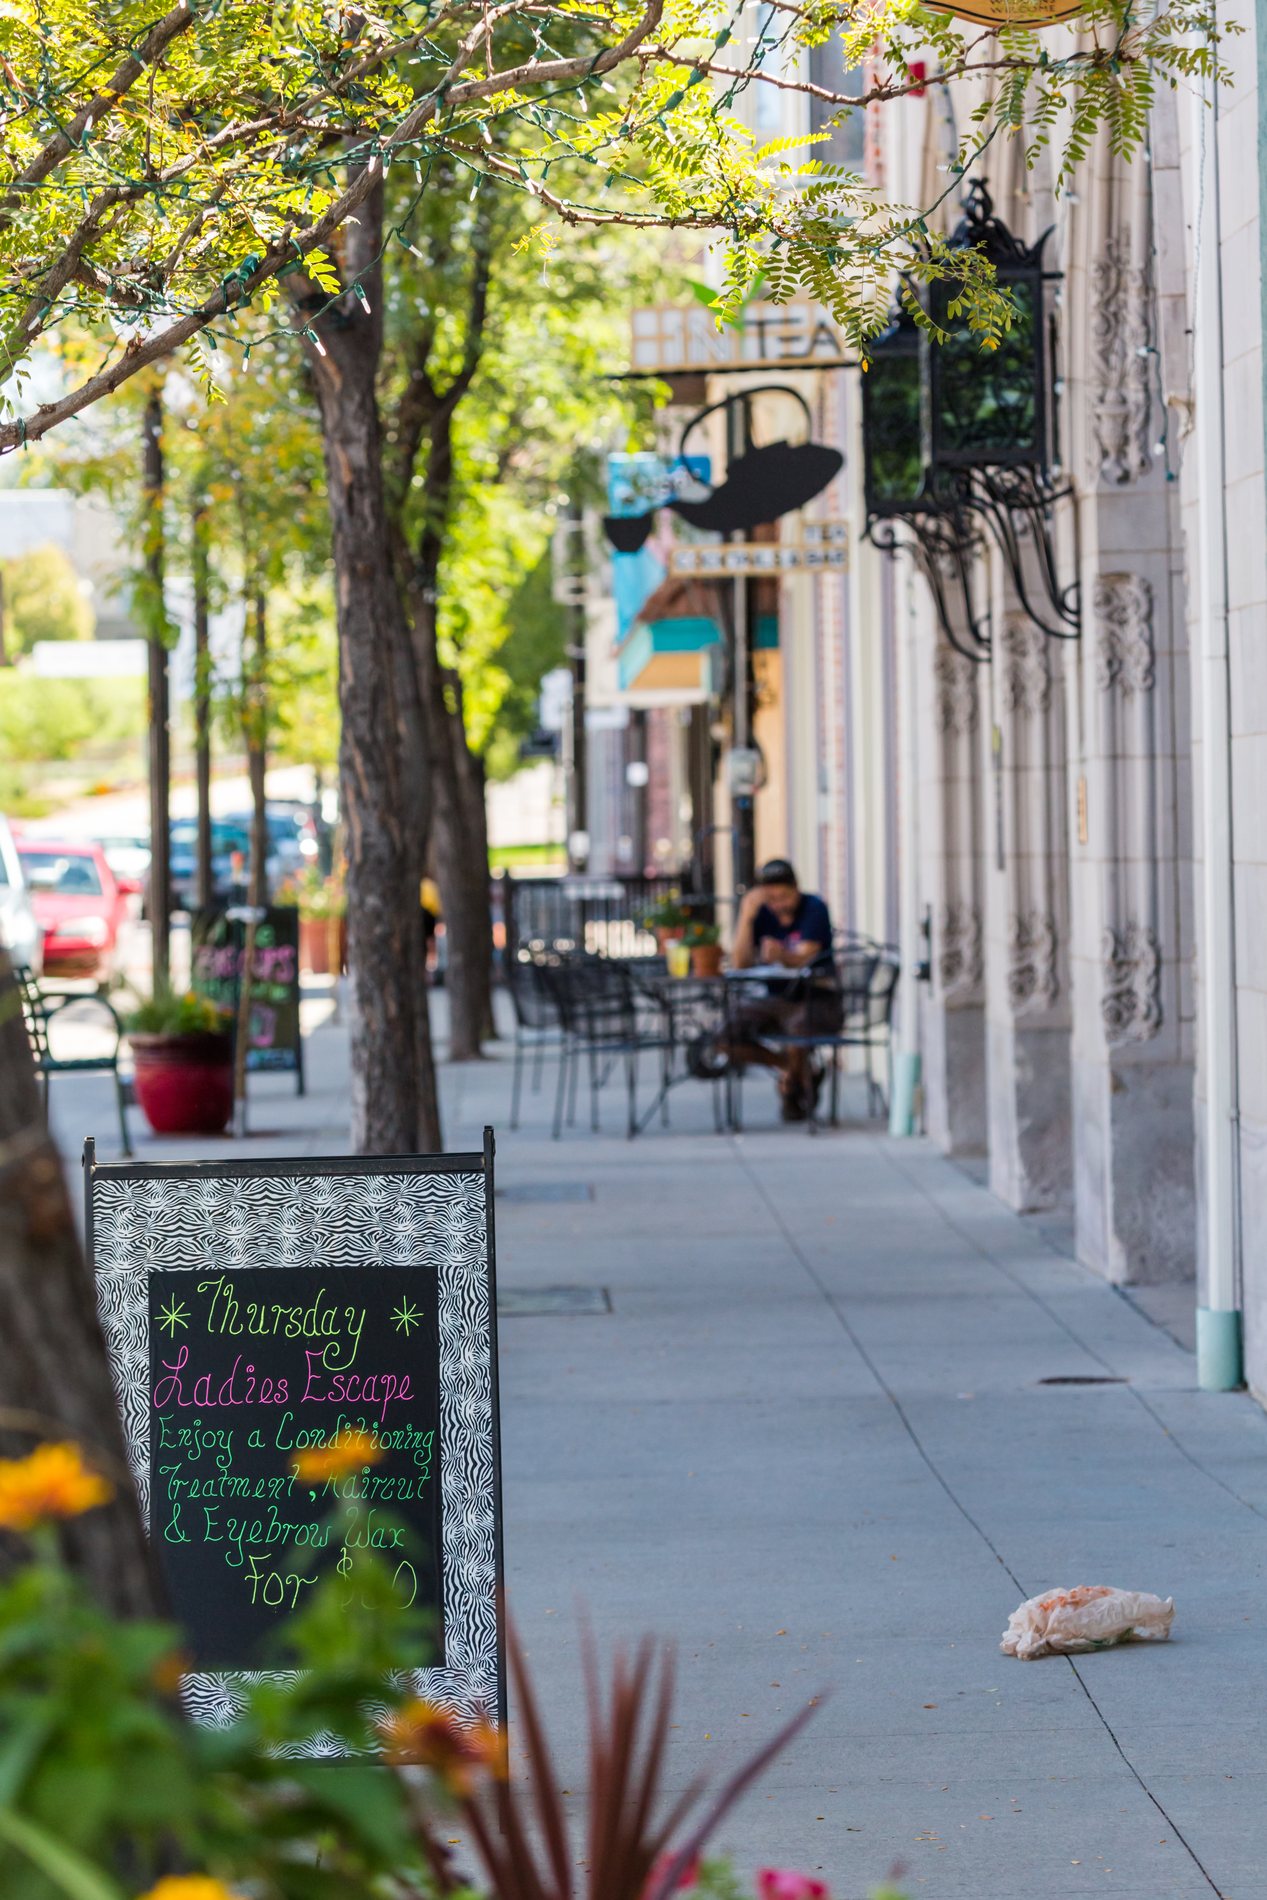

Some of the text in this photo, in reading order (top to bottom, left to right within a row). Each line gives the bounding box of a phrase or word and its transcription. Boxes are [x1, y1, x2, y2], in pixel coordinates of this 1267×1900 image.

[197, 1275, 366, 1370] Thursday
[153, 1345, 415, 1422] Ladies Escape
[159, 1411, 435, 1468] Enjoy a Conditioning
[322, 1464, 432, 1501] Haircut
[164, 1502, 406, 1567] & Eyebrow Wax
[244, 1547, 418, 1614] For $0
